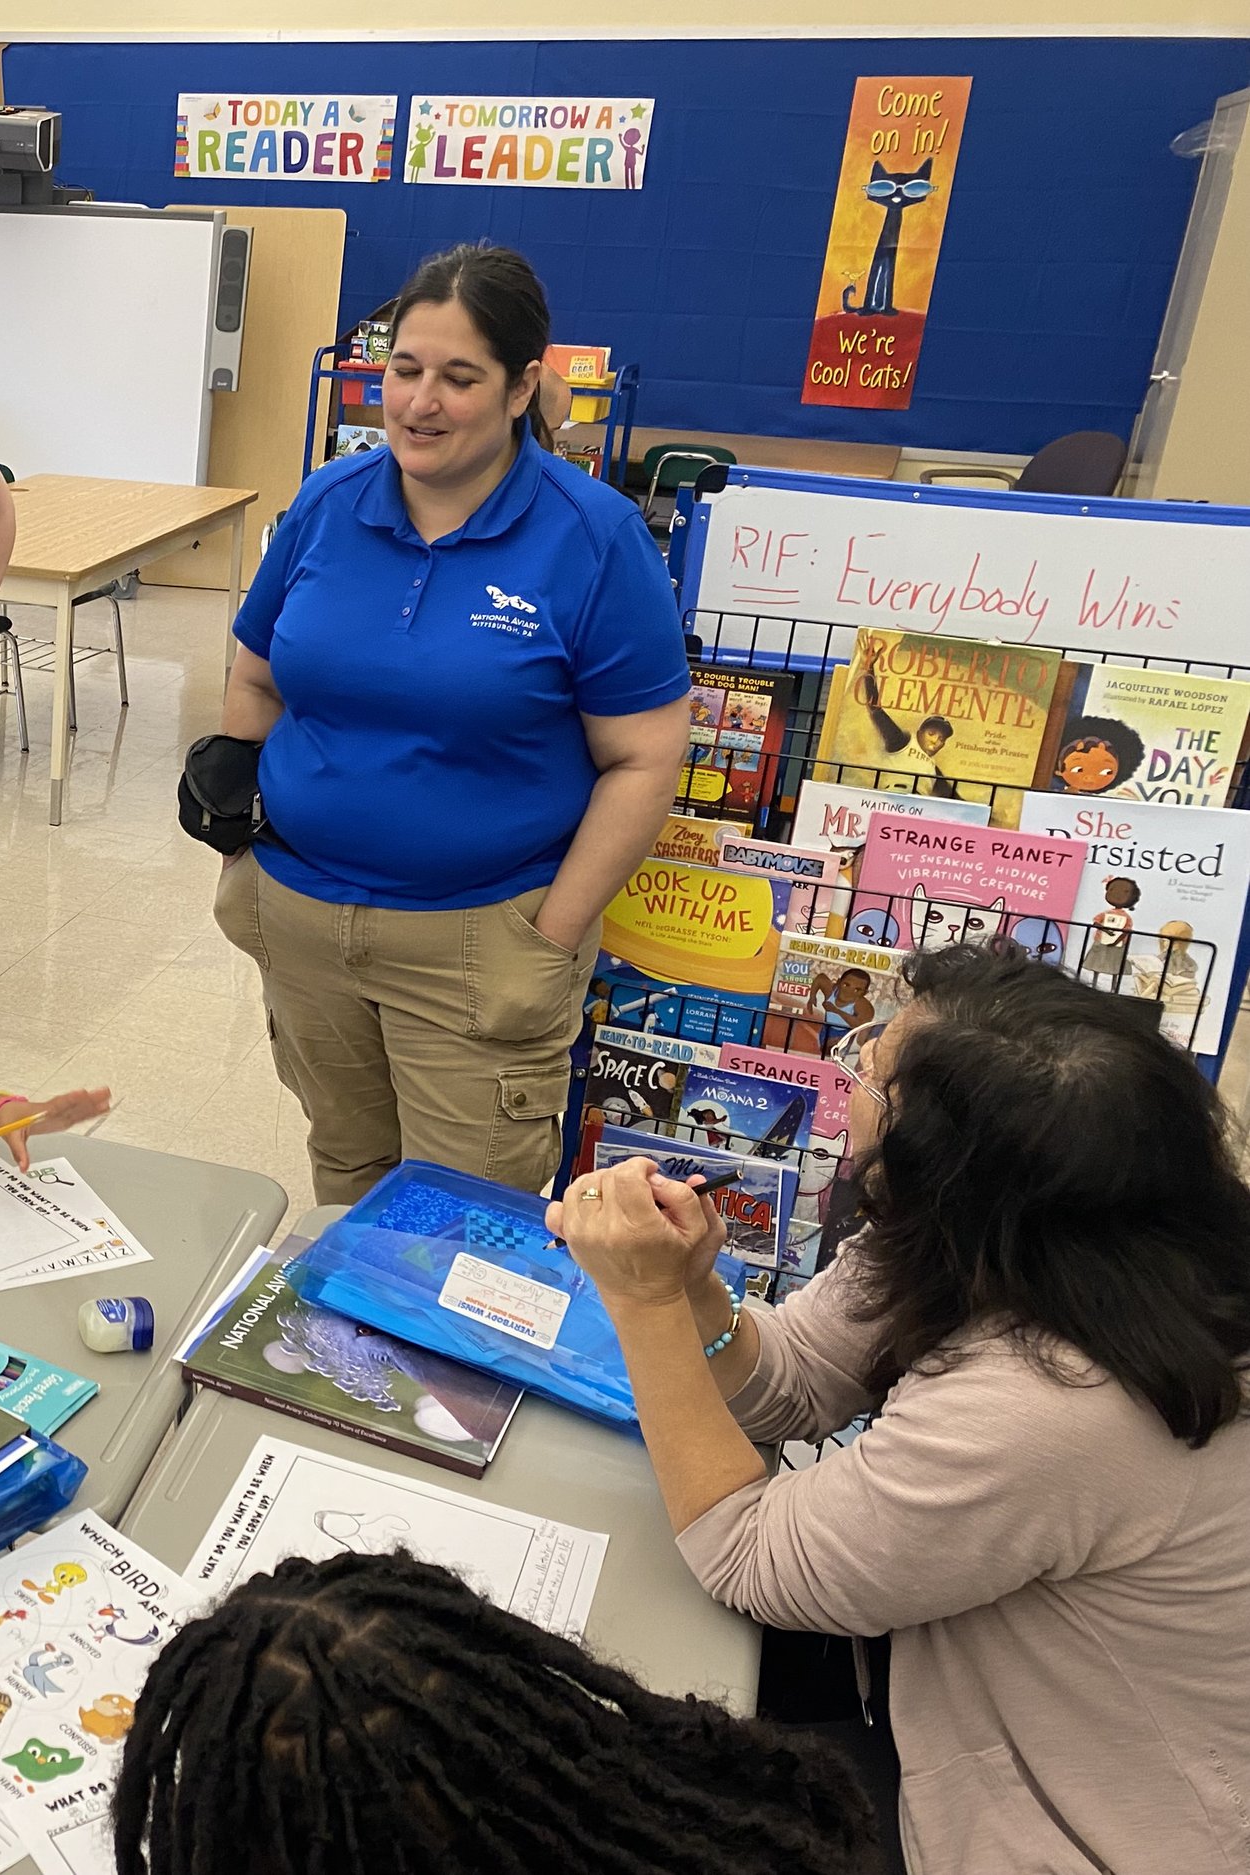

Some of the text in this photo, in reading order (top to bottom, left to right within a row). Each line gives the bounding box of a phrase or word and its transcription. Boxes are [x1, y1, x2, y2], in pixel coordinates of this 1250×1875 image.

[228, 100, 339, 127] TODAY A
[444, 103, 613, 129] TOMORROW A
[878, 85, 943, 117] Come
[871, 119, 949, 154] on in!
[198, 130, 364, 176] READER
[434, 134, 625, 183] LEADER
[839, 329, 895, 356] We're
[811, 359, 912, 389] Cool Cats!
[731, 526, 817, 577] RIF:
[837, 533, 1049, 643] Everybody
[511, 617, 540, 630] AVIARY
[862, 636, 1048, 691] ROBERTO
[739, 677, 775, 687] TROUBLE
[1106, 681, 1229, 703] JACQUELINE WOODSON
[853, 674, 1035, 729] CLEMENTE
[1148, 698, 1188, 710] RAFAEL
[1175, 727, 1221, 753] THE
[1147, 748, 1218, 789] DAY
[860, 799, 923, 816] WAITING ON
[673, 825, 707, 846] Zoey
[1075, 810, 1132, 840] She
[654, 840, 720, 866] SASSAFRAS
[723, 844, 825, 878] BABYMOUSE
[879, 826, 1073, 867] STRANGE PLANET
[1046, 827, 1226, 878] rsisted
[890, 853, 1051, 888] THE SNEAKING, HIDING,
[898, 868, 1048, 900] VIBRATING CREATURE
[626, 870, 737, 905] LOOK UP
[635, 920, 654, 929] NEIL
[644, 895, 754, 933] WITH ME
[783, 962, 809, 975] YOU
[778, 982, 810, 996] MEET
[722, 1016, 739, 1024] NAM
[729, 1058, 821, 1087] STRANGE
[701, 1086, 769, 1110] MOANA 2
[5, 1183, 18, 1194] YOU
[17, 1193, 37, 1206] GROW
[18, 1181, 31, 1191] YOU
[30, 1190, 52, 1205] WANT
[50, 1204, 61, 1212] TO
[70, 1218, 92, 1232] WHEN
[219, 1256, 302, 1350] NATIONAL AVIARY
[458, 1300, 536, 1338] EVERYBODY WINS!
[199, 1454, 275, 1579] WHAT DO YOU WANT TO BE WHEN
[235, 1495, 274, 1551] YOU GROW UP?
[80, 1523, 124, 1558] WHICH
[109, 1560, 160, 1598] BIRD
[137, 1600, 168, 1621] ARE
[69, 1633, 102, 1660] ANNOYED
[5, 1675, 37, 1701] HUNGRY
[59, 1723, 98, 1757] CONFUSED
[45, 1782, 108, 1813] WHAT DO
